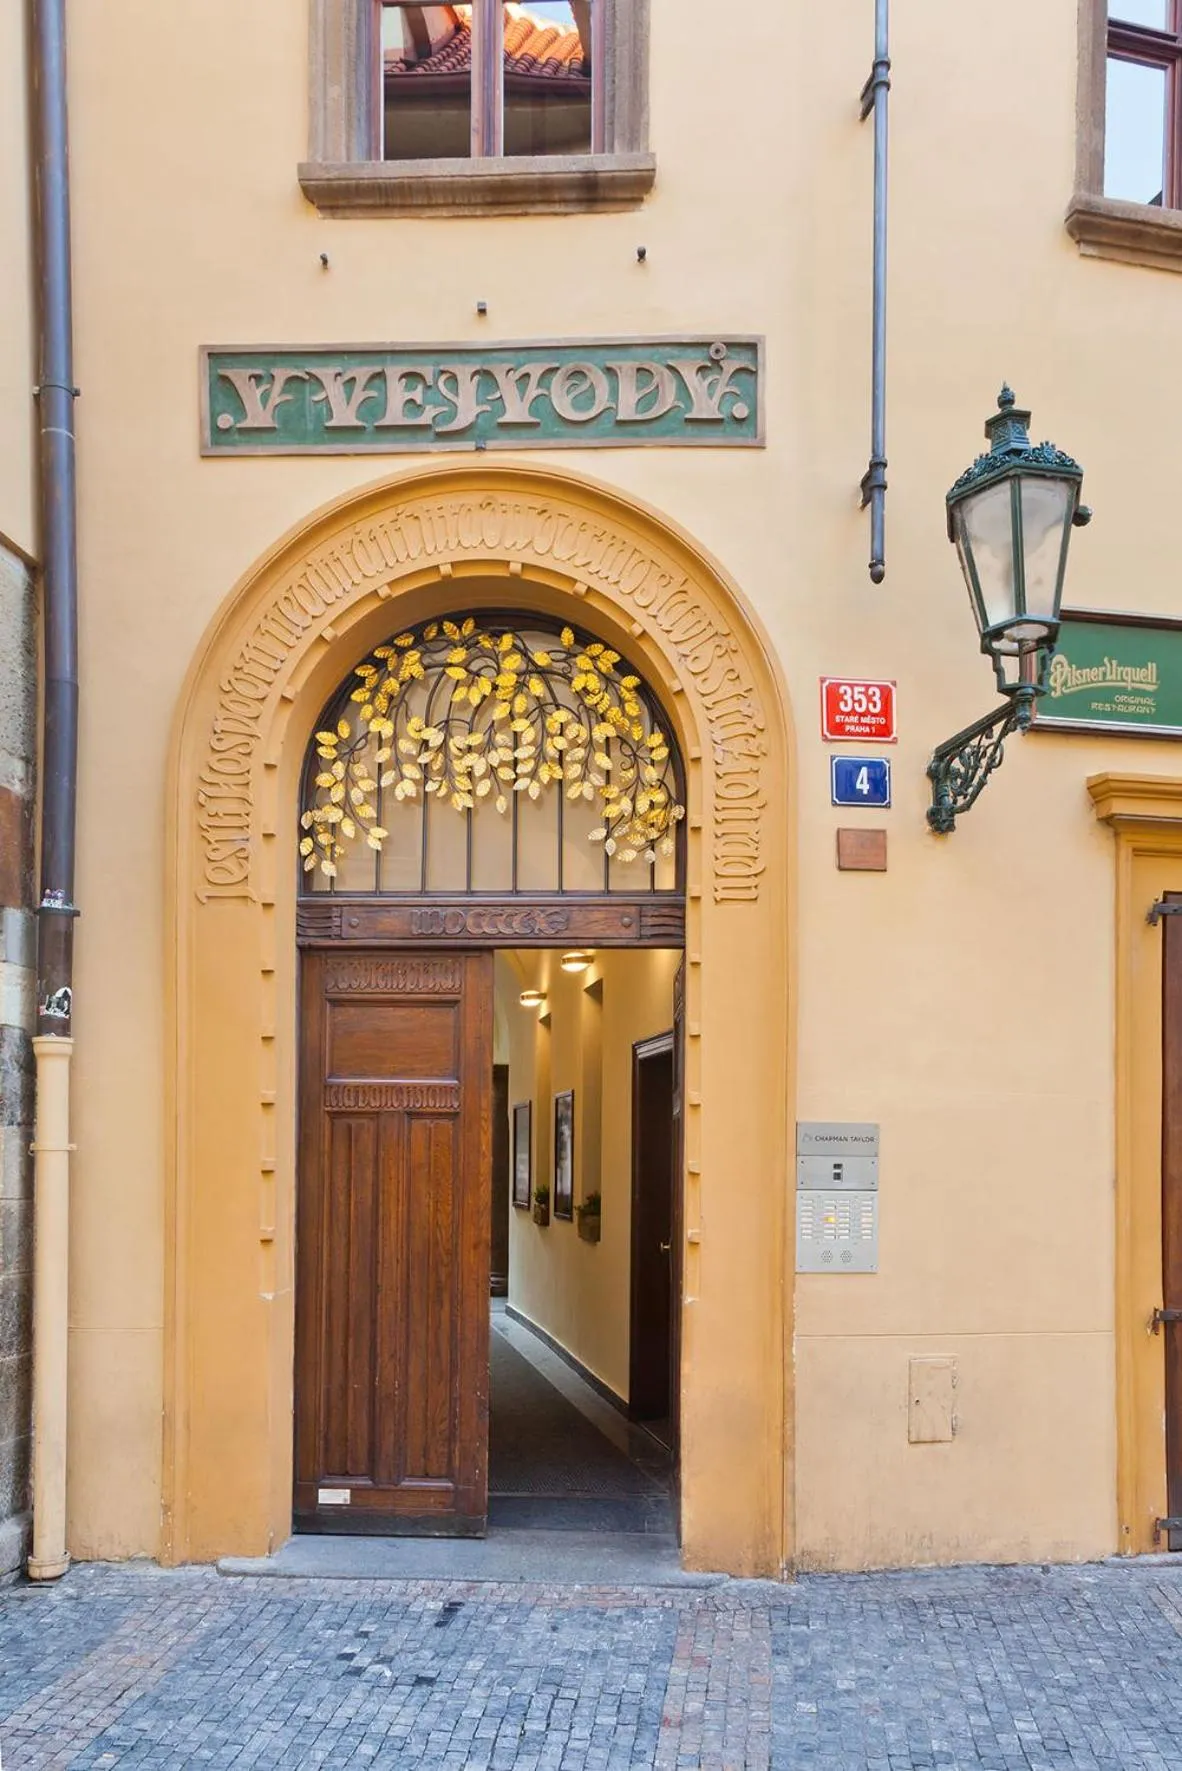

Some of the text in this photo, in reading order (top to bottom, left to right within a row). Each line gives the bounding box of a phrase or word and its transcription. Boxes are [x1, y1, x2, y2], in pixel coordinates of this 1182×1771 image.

[1049, 654, 1157, 697] Pilsner Urquell
[839, 686, 882, 713] 353
[1091, 702, 1156, 714] RESTAURANT
[1114, 695, 1156, 705] ORIGINAL
[845, 724, 870, 733] PRAHA
[855, 766, 870, 795] 4
